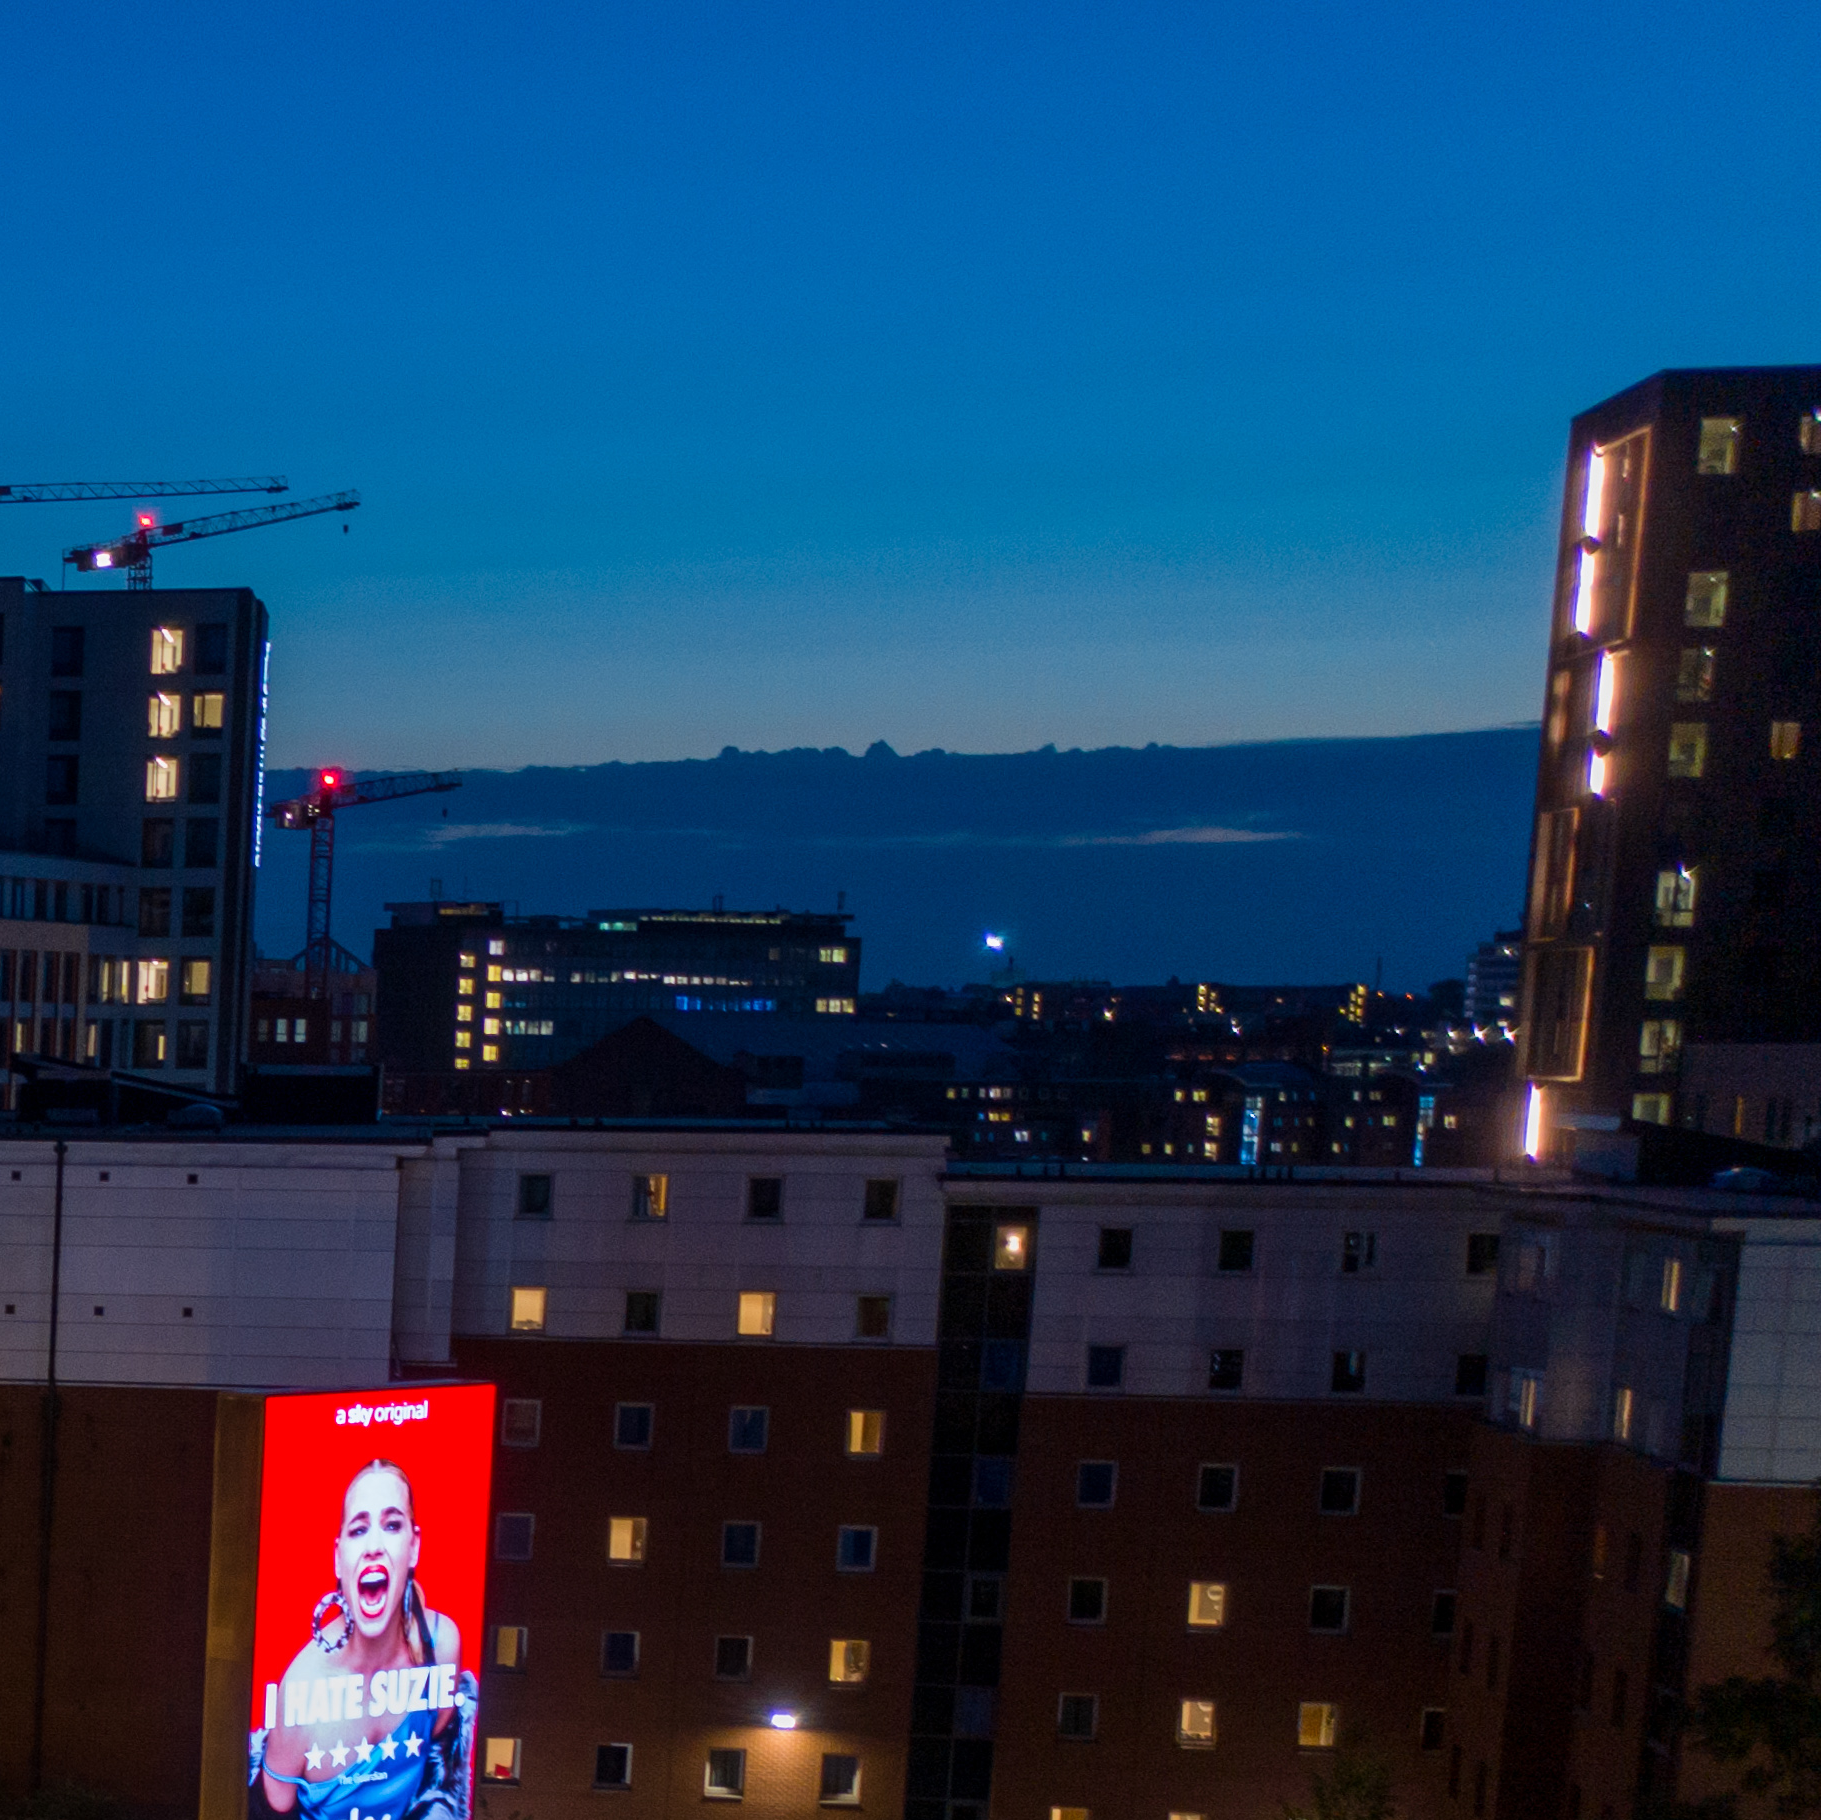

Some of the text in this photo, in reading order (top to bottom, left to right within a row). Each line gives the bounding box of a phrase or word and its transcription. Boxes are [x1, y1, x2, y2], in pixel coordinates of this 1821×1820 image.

[335, 1399, 429, 1427] a sky original
[265, 1663, 465, 1729] I HATE SUZIE.
